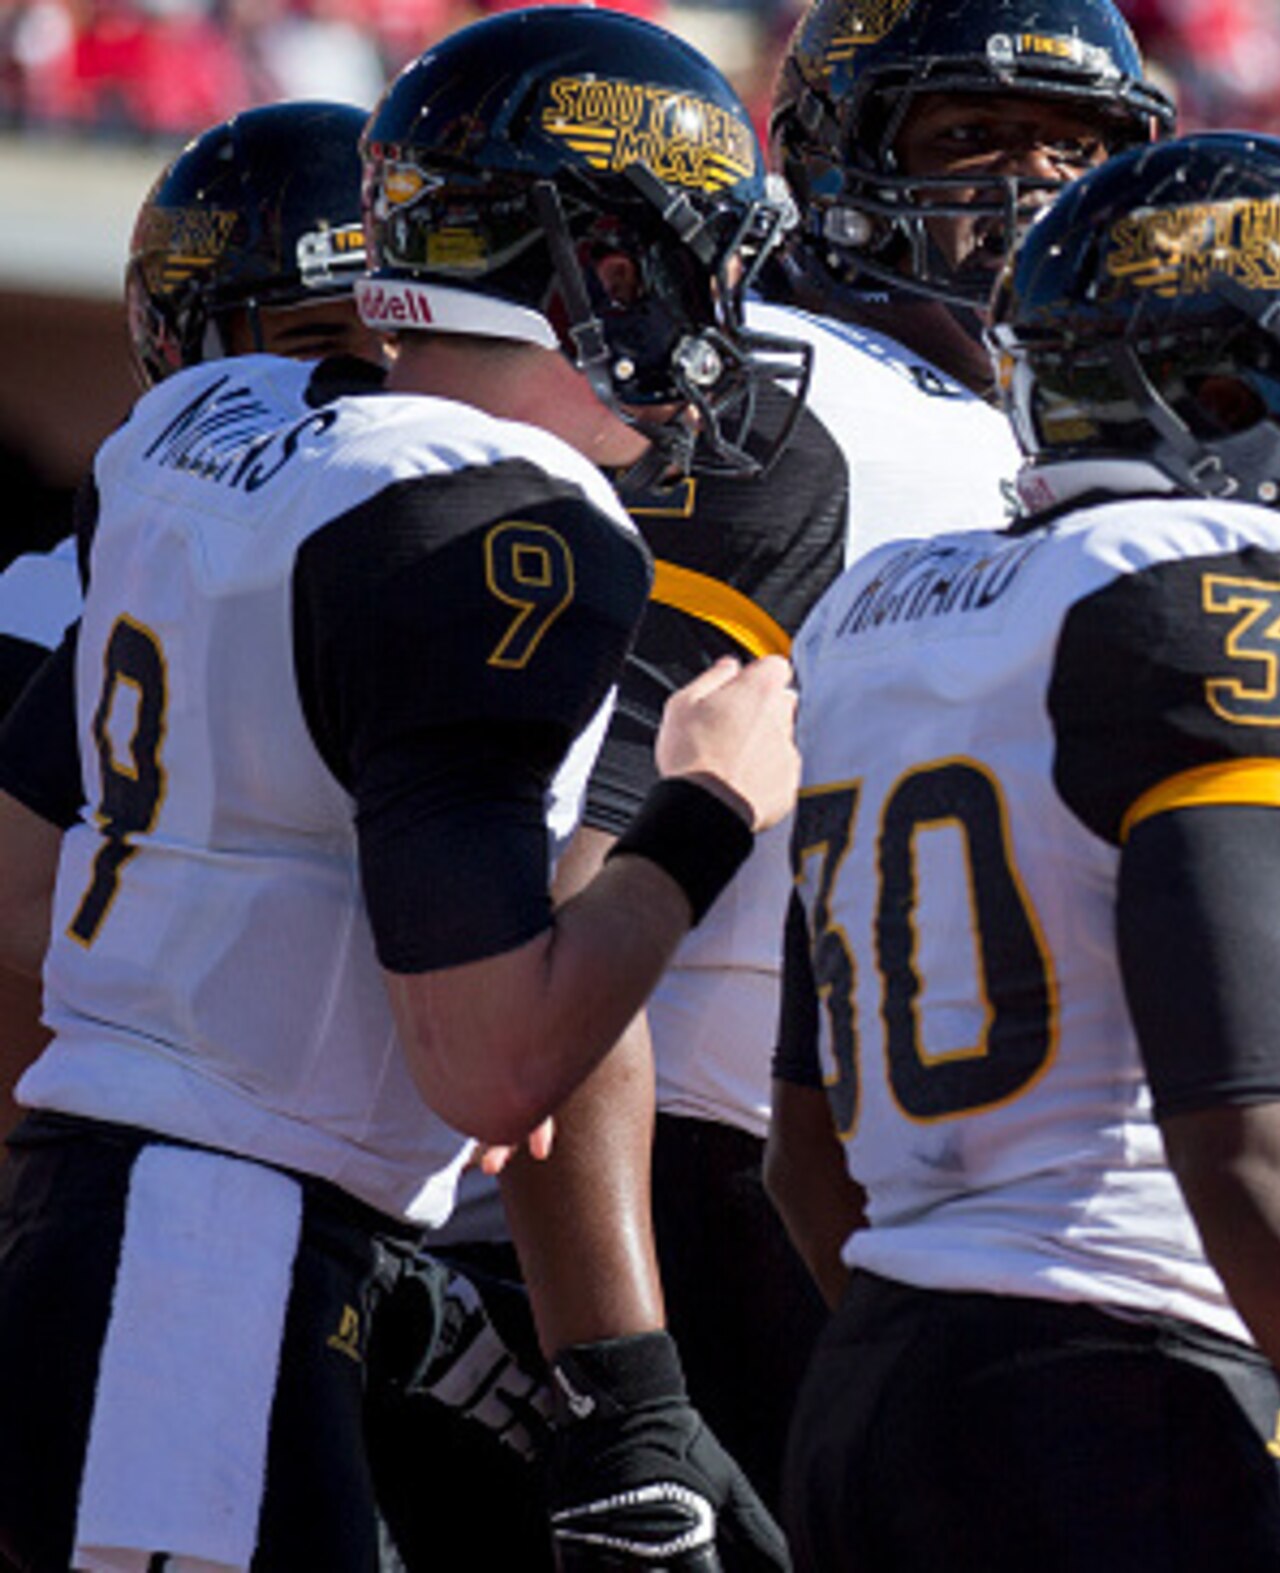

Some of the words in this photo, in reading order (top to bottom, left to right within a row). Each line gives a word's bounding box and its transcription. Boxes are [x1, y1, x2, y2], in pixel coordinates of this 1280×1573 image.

[484, 521, 575, 669] 9
[66, 614, 168, 949] 9
[793, 755, 1060, 1142] 30
